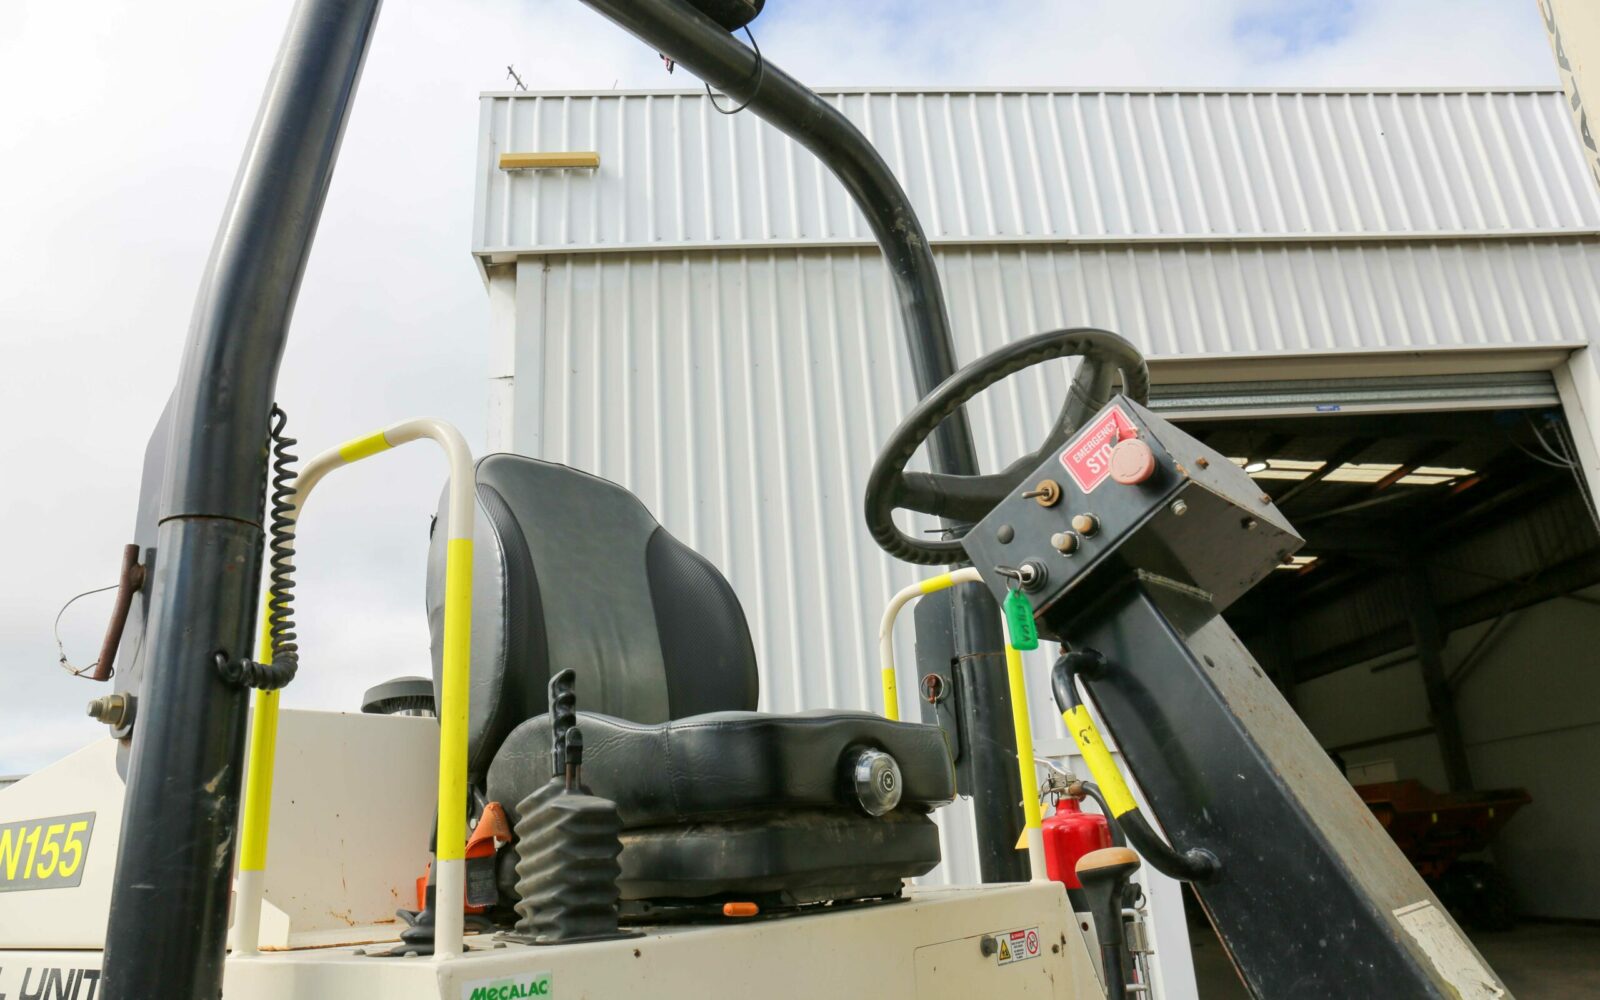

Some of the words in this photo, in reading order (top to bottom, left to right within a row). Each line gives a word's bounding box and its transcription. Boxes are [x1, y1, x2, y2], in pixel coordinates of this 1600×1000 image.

[1071, 419, 1117, 464] EMERGENCY
[1085, 443, 1115, 474] STO
[0, 821, 88, 880] N155
[18, 967, 101, 1000] UNIT
